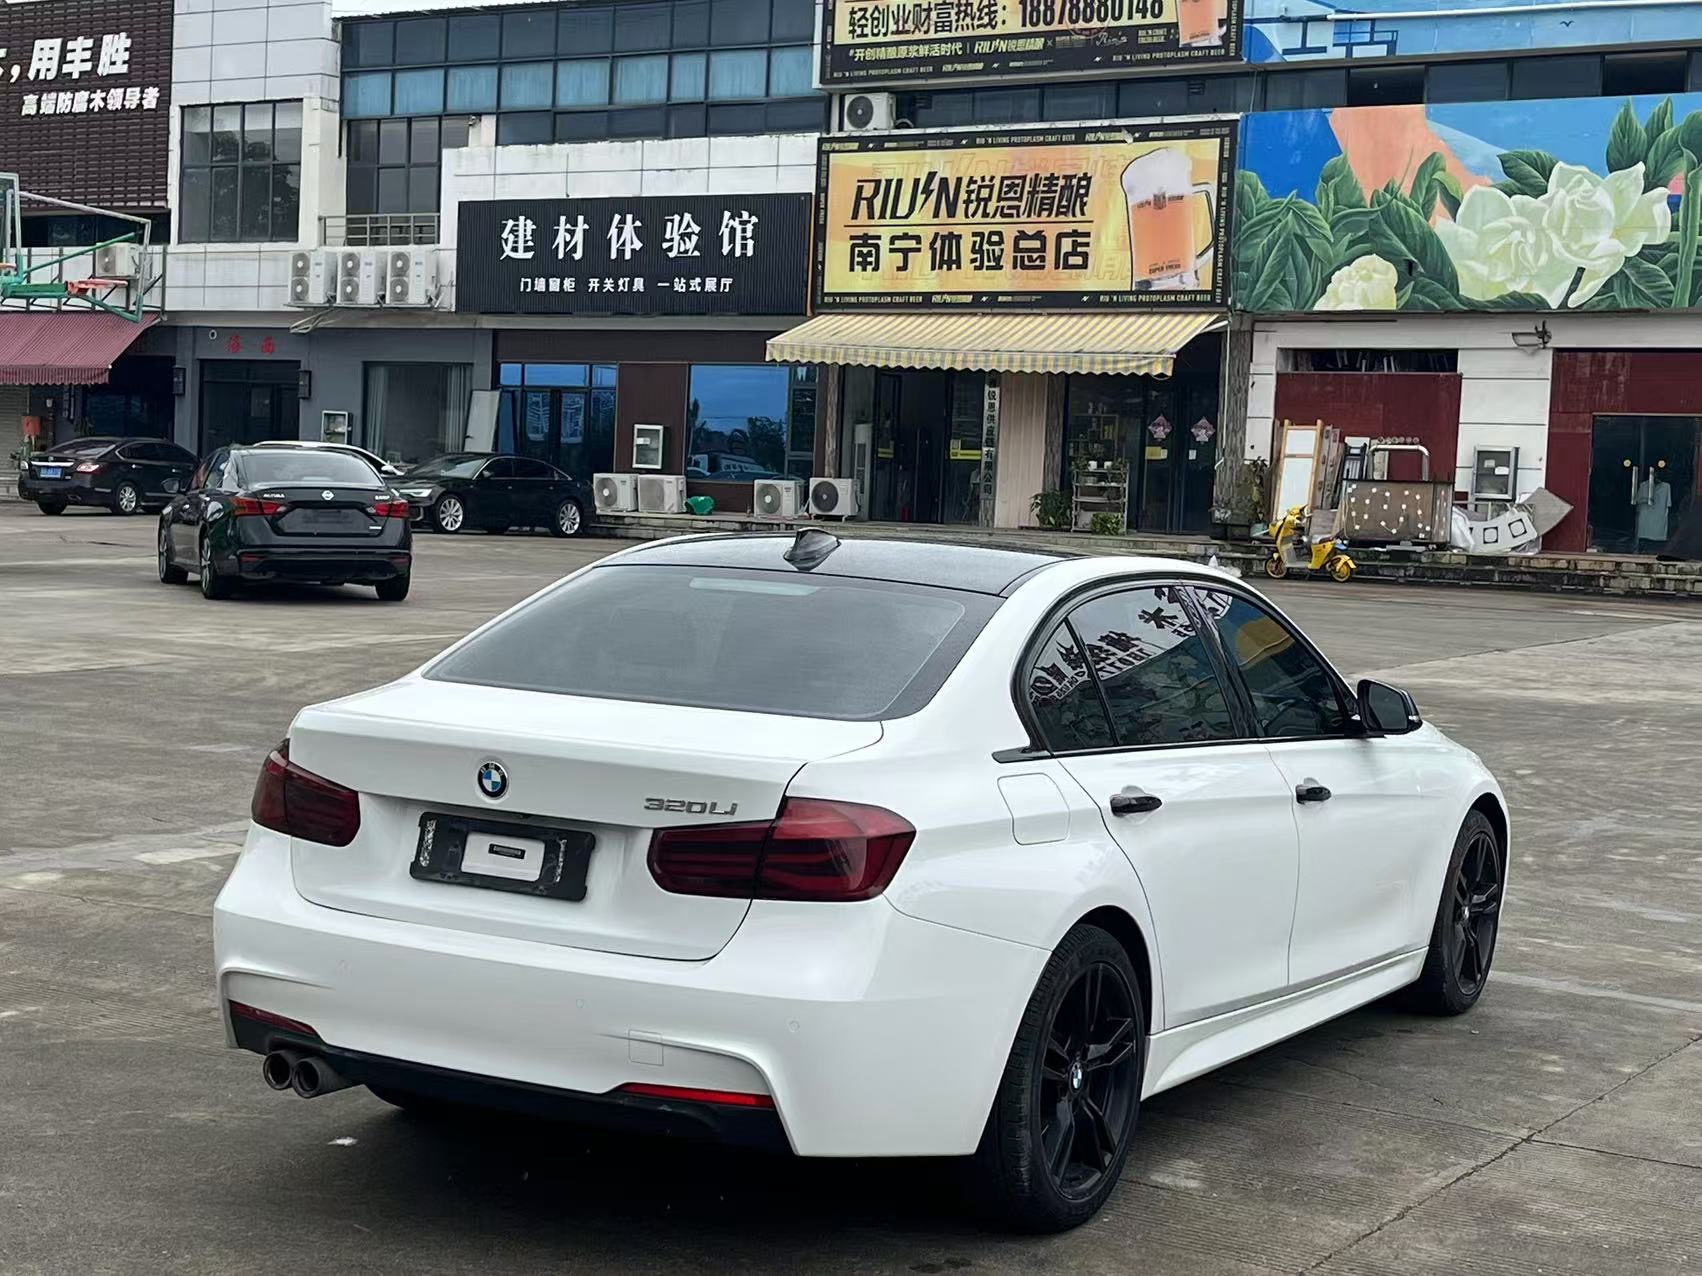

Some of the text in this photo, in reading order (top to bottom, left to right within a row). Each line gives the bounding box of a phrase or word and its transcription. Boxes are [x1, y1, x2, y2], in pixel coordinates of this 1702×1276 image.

[0, 32, 132, 83] ，用丰胜
[500, 210, 759, 261] 建材体验馆
[849, 229, 1092, 272] 南宁体验总店
[587, 277, 645, 293] 开关灯具
[657, 276, 734, 293] 一站式展厅
